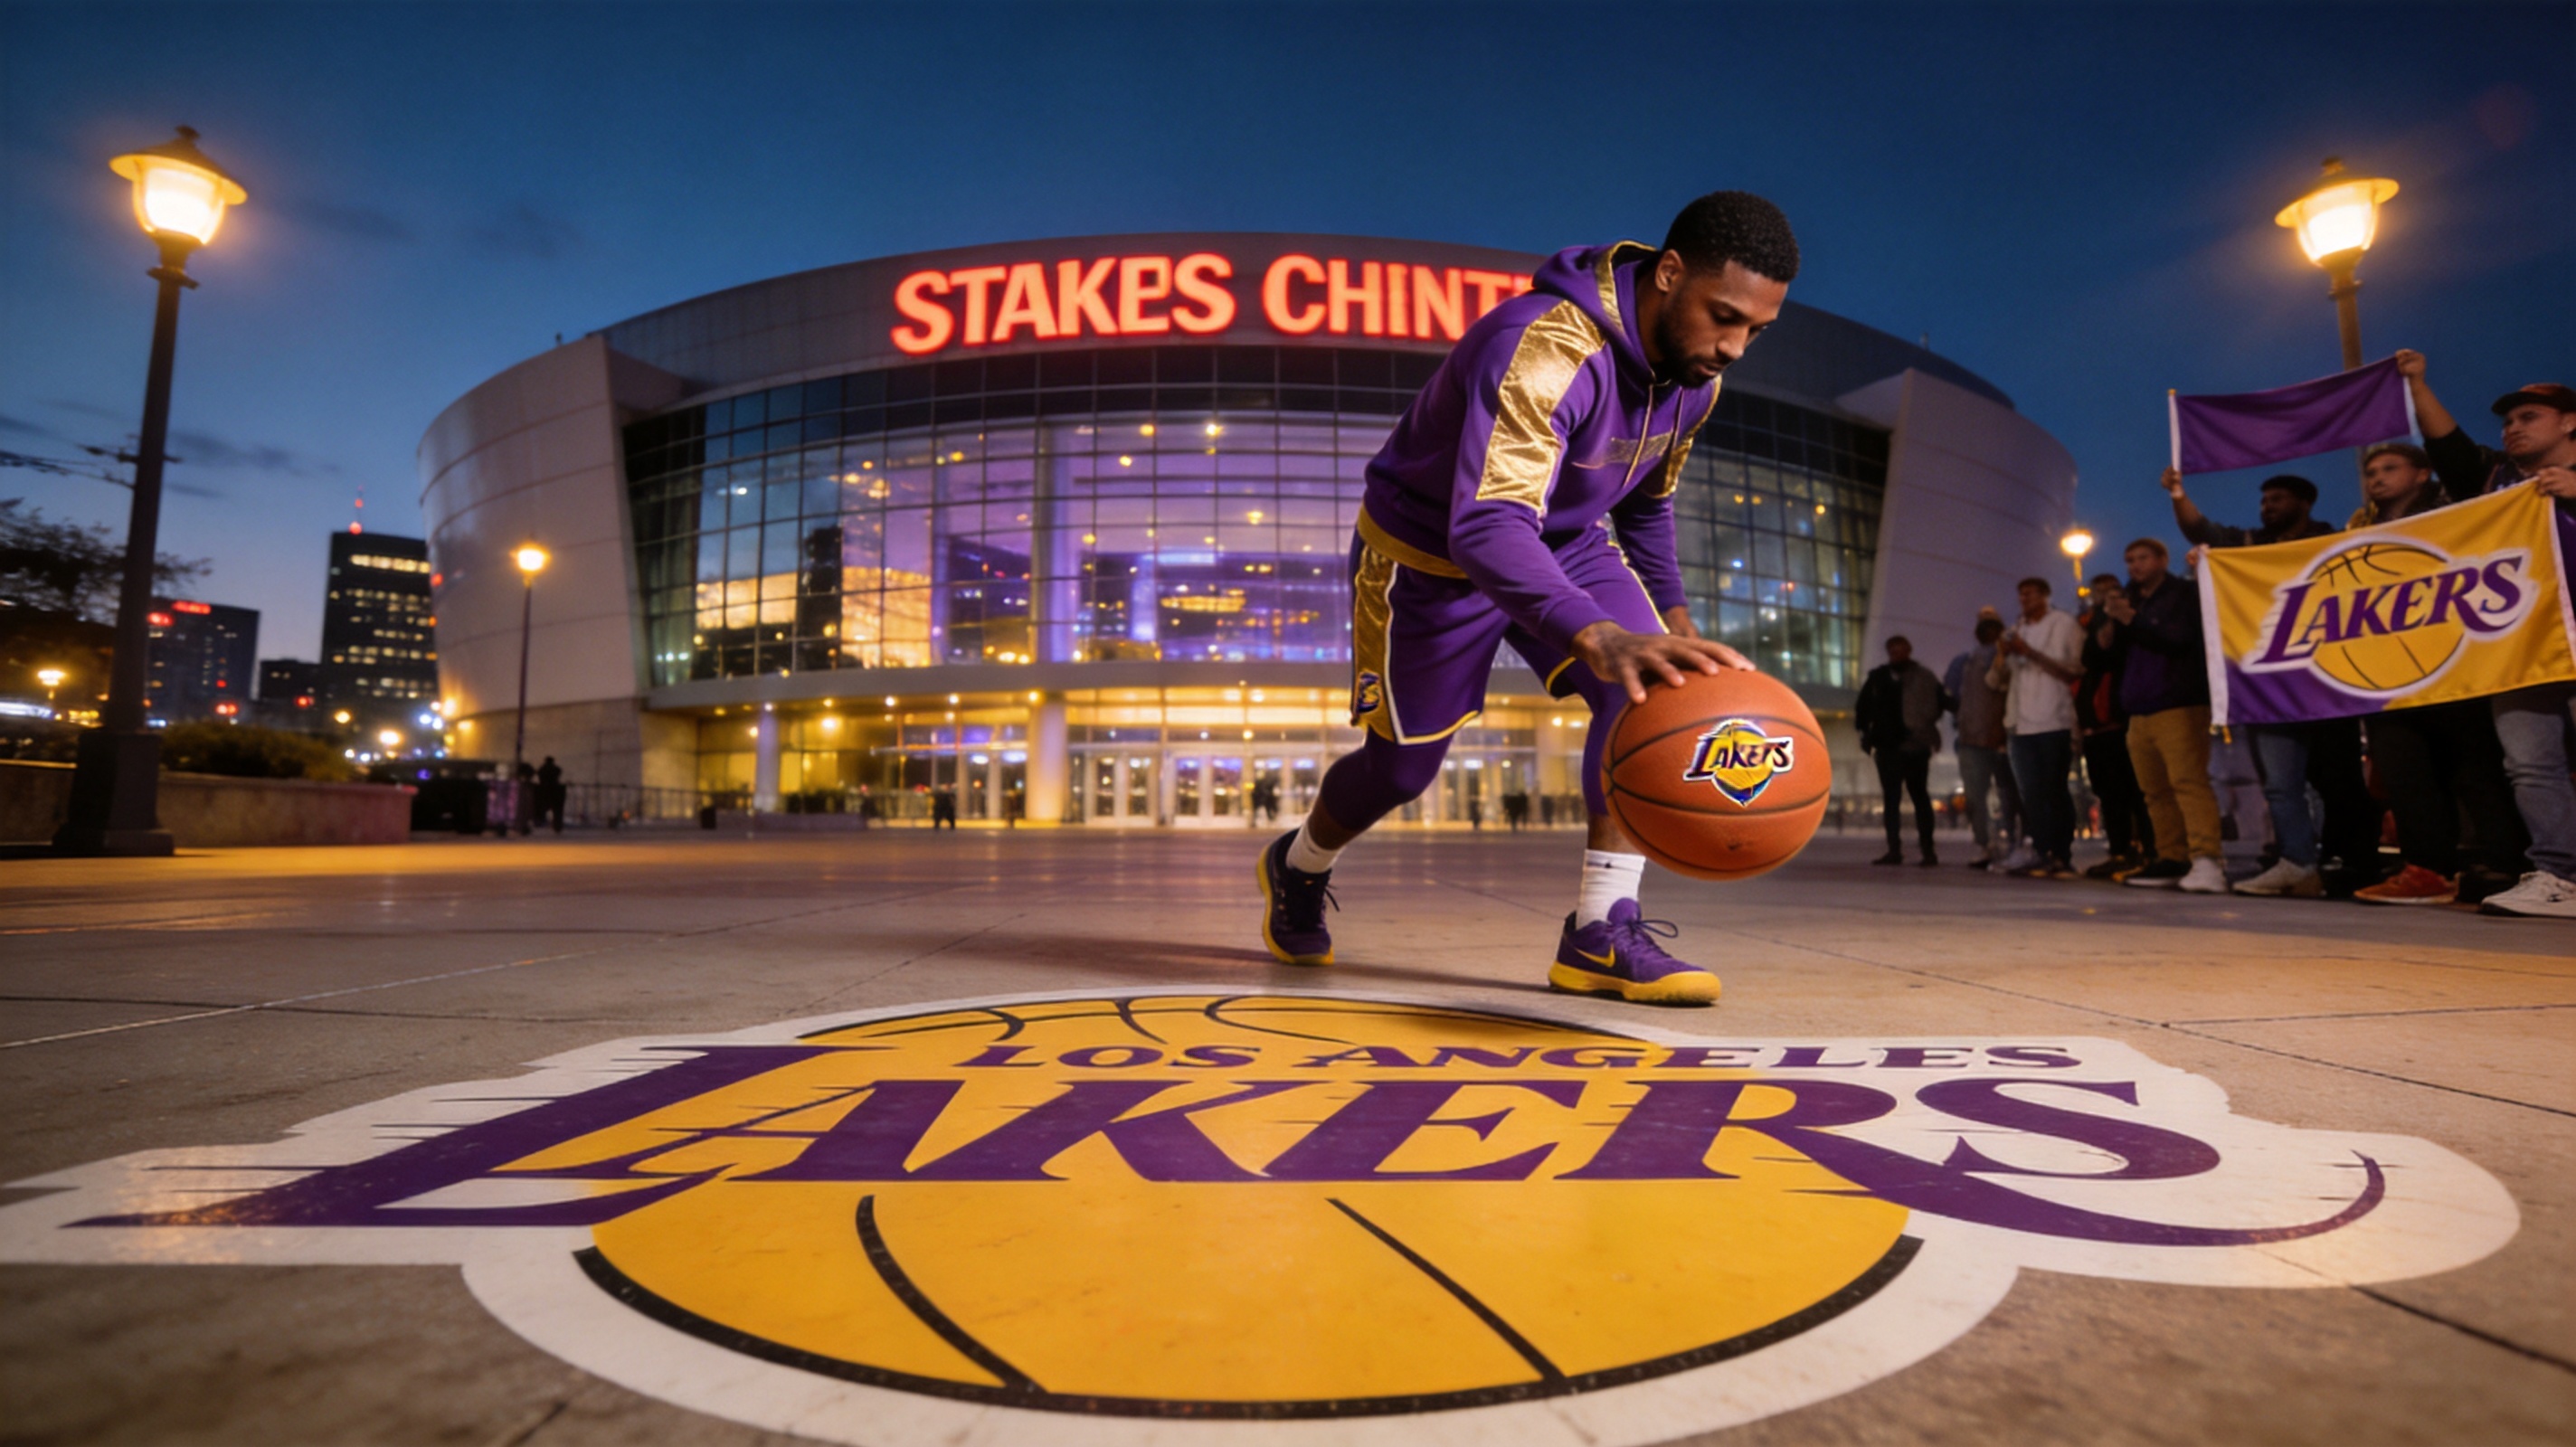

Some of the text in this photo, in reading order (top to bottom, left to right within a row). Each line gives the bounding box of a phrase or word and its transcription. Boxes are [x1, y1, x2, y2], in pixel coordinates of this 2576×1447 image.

[1262, 253, 1535, 341] CHINT
[2250, 554, 2524, 665] LAKERS
[951, 1045, 2083, 1068] LOS ANGELES
[59, 1045, 2386, 1247] LAKERS
